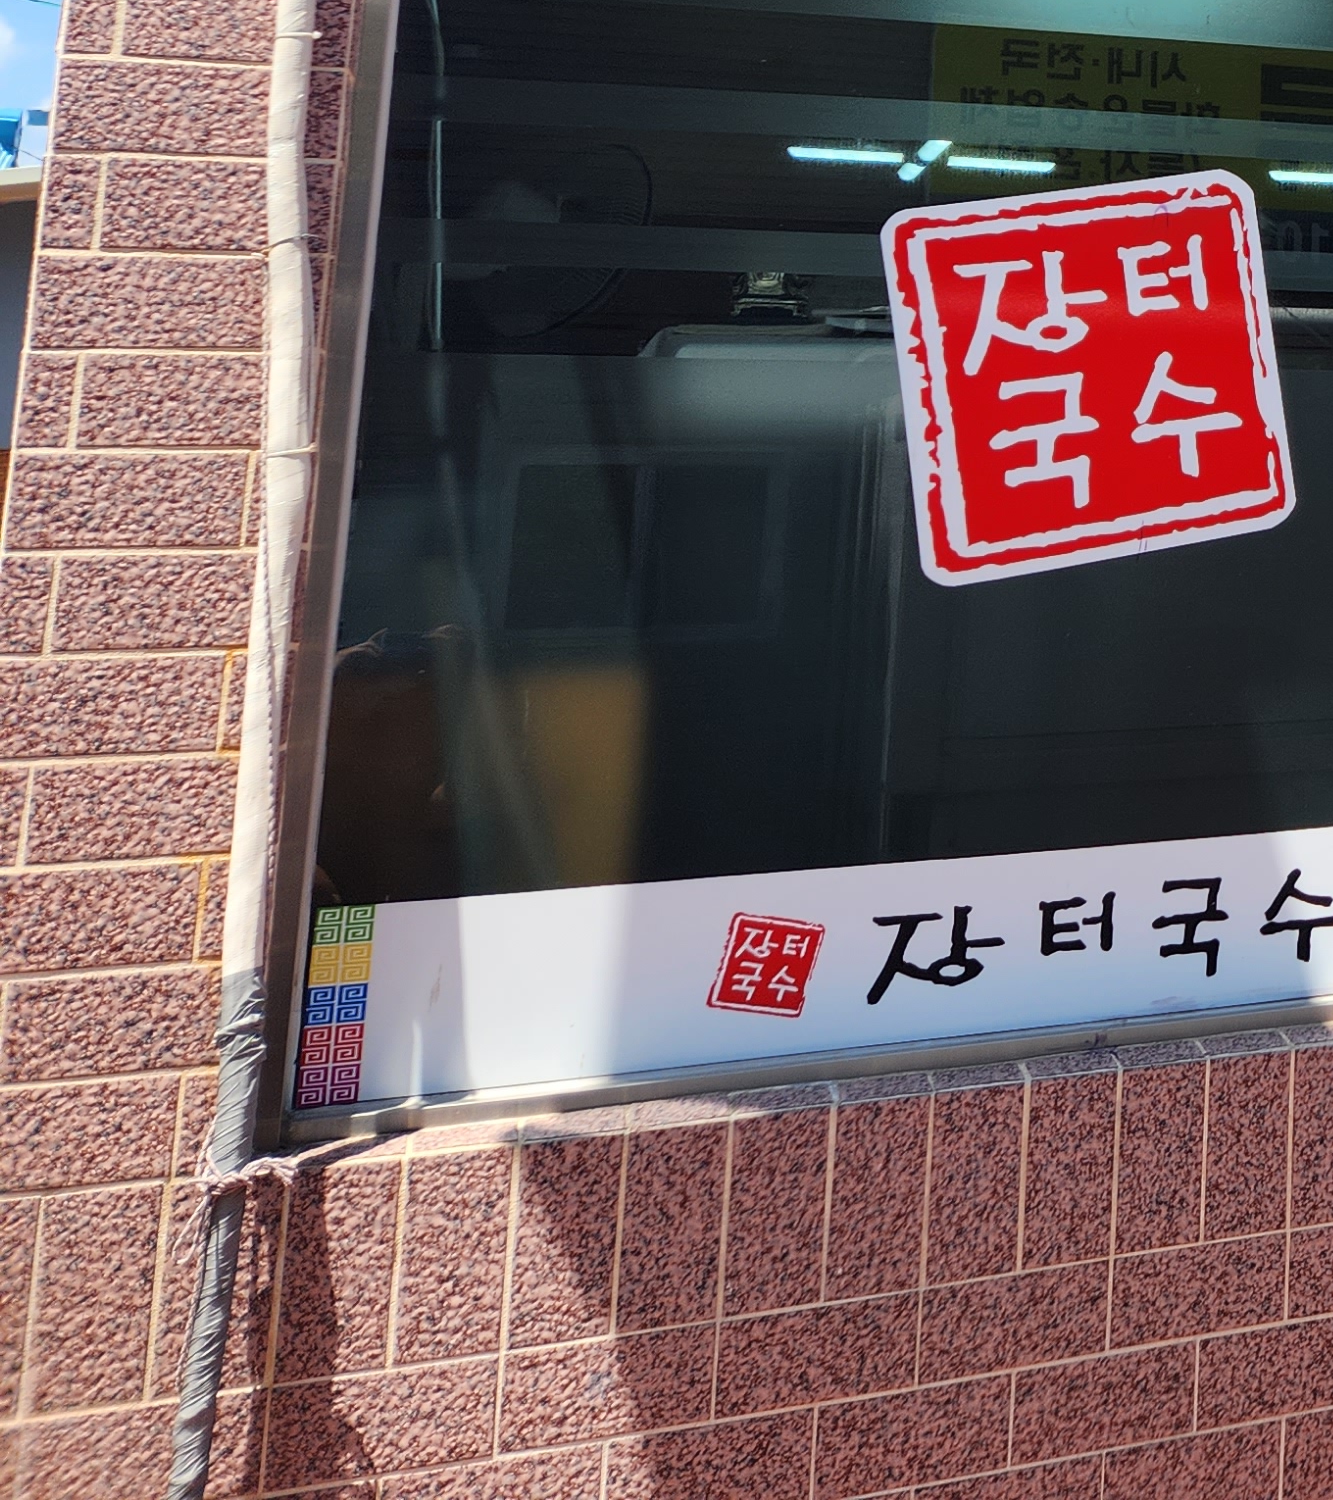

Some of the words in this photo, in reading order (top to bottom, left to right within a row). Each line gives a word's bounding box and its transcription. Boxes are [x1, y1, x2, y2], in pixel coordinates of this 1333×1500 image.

[952, 233, 1209, 376] 장터
[988, 350, 1244, 509] 국수
[730, 960, 799, 1002] 국수
[733, 926, 811, 959] 장터
